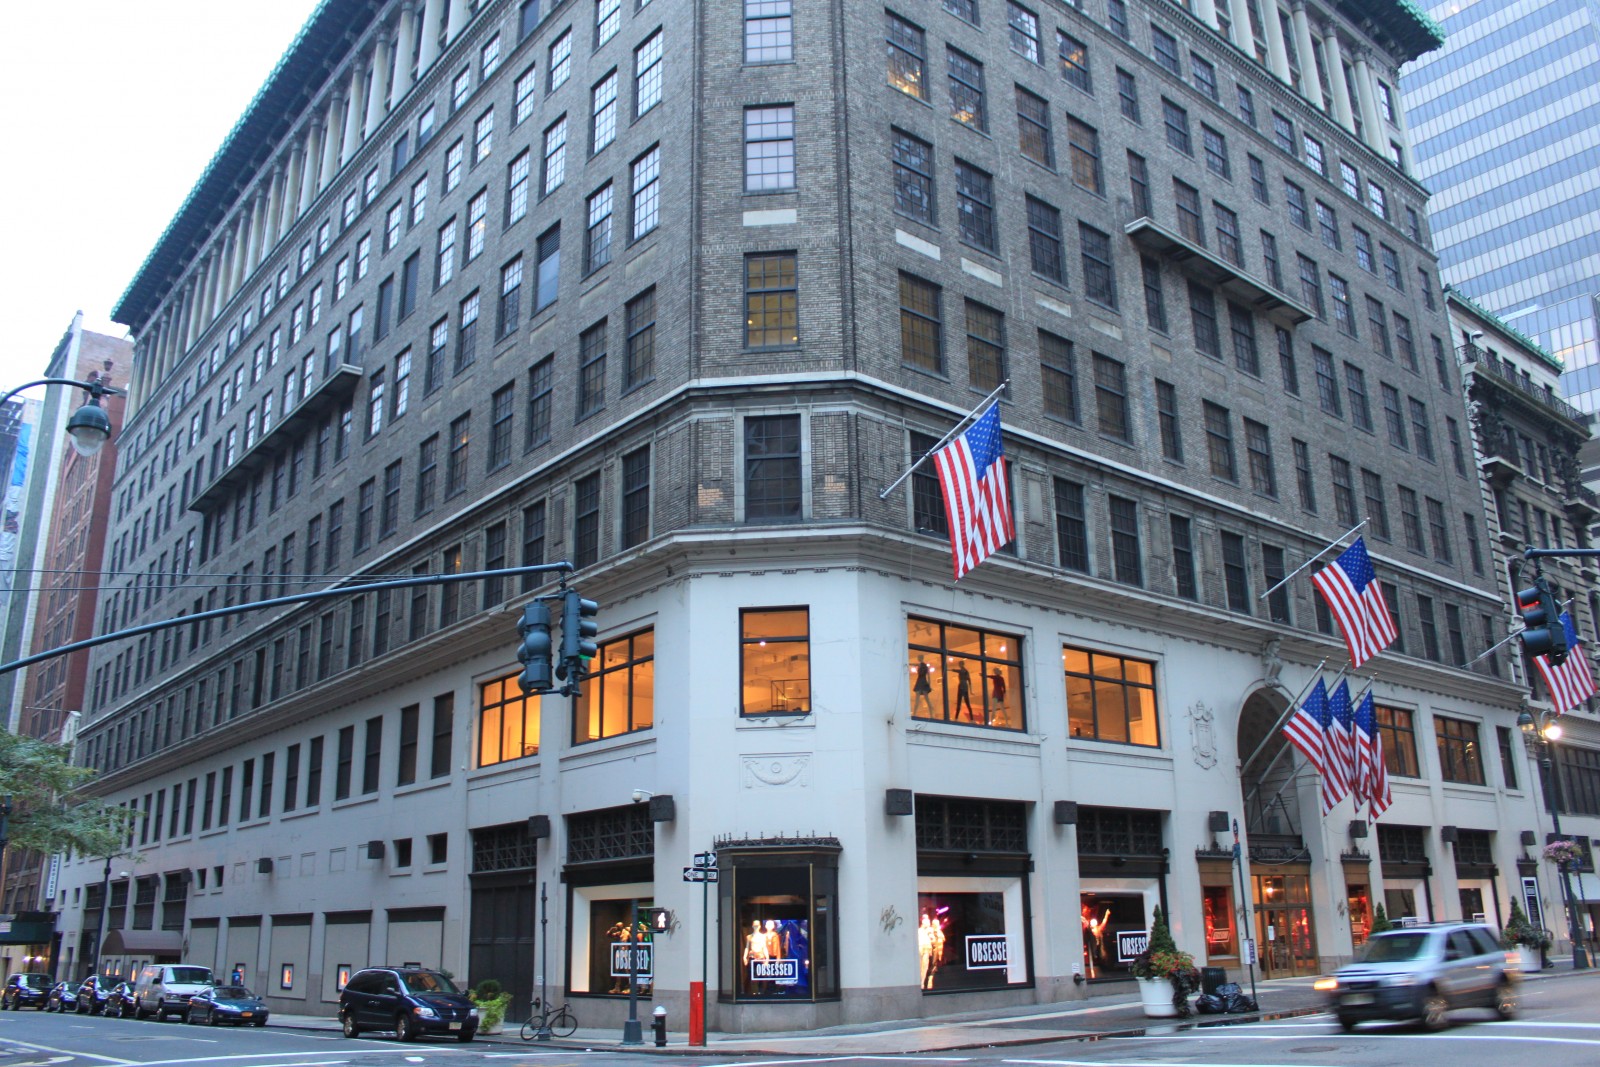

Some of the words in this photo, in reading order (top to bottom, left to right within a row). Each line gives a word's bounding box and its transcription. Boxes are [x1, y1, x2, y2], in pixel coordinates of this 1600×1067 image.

[1122, 937, 1149, 955] OBSESS
[615, 950, 649, 970] OBSESED
[756, 963, 793, 976] OBSESSED
